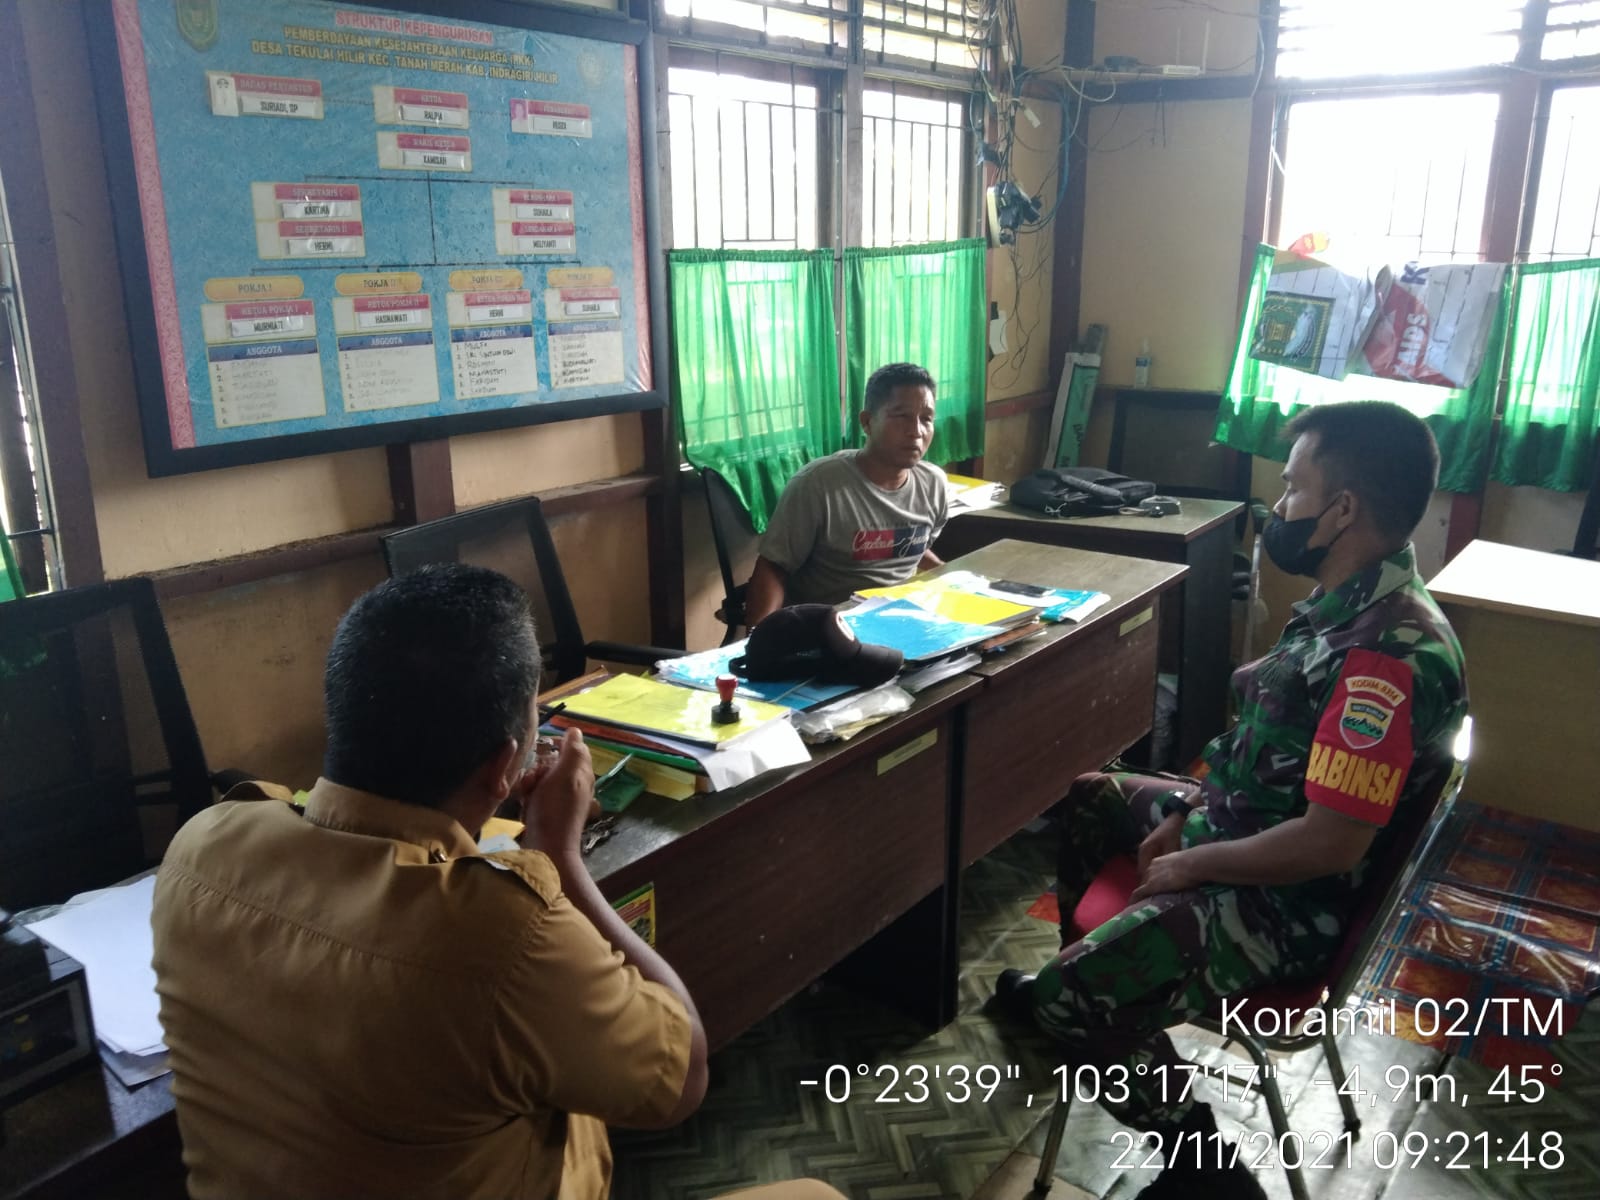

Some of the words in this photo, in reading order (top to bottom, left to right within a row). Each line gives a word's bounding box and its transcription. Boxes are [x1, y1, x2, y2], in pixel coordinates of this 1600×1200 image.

[336, 10, 402, 33] STRUKTUR
[404, 19, 493, 44] KEPENGURUSAN
[284, 25, 371, 47] PEMBERDAYAAN
[374, 38, 458, 56] KESEJAHTERAAN
[461, 47, 508, 63] KELUARGA
[251, 40, 282, 55] DESA
[286, 44, 333, 60] TEKULAI
[336, 49, 365, 64] HILIR
[395, 55, 428, 70] TANAH
[431, 60, 463, 73] MERAH
[534, 71, 559, 84] HILIR
[238, 284, 267, 294] POKJA
[363, 279, 389, 289] POKJA
[269, 304, 295, 315] POKJA
[371, 336, 403, 346] ANGGOTA
[246, 345, 283, 356] ANGGOTA
